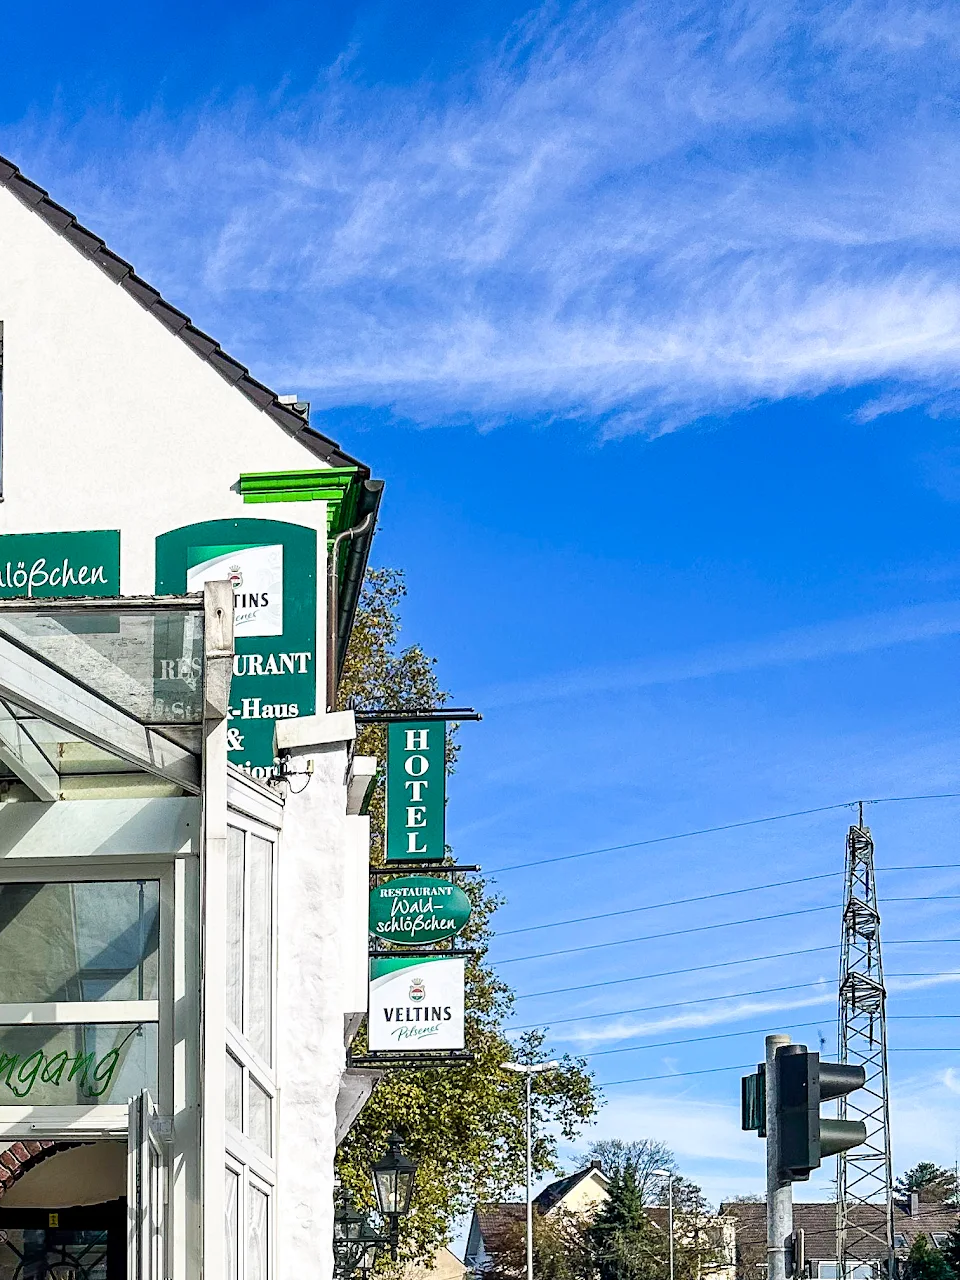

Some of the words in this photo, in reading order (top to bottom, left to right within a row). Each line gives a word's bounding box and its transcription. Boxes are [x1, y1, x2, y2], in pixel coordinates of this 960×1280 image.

[403, 728, 429, 854] HOTEL
[379, 886, 453, 898] RESTAURANT
[390, 896, 444, 917] Wald-
[376, 914, 457, 938] schlößchen
[383, 1006, 452, 1023] VELTINS
[390, 1023, 442, 1042] Pilsener
